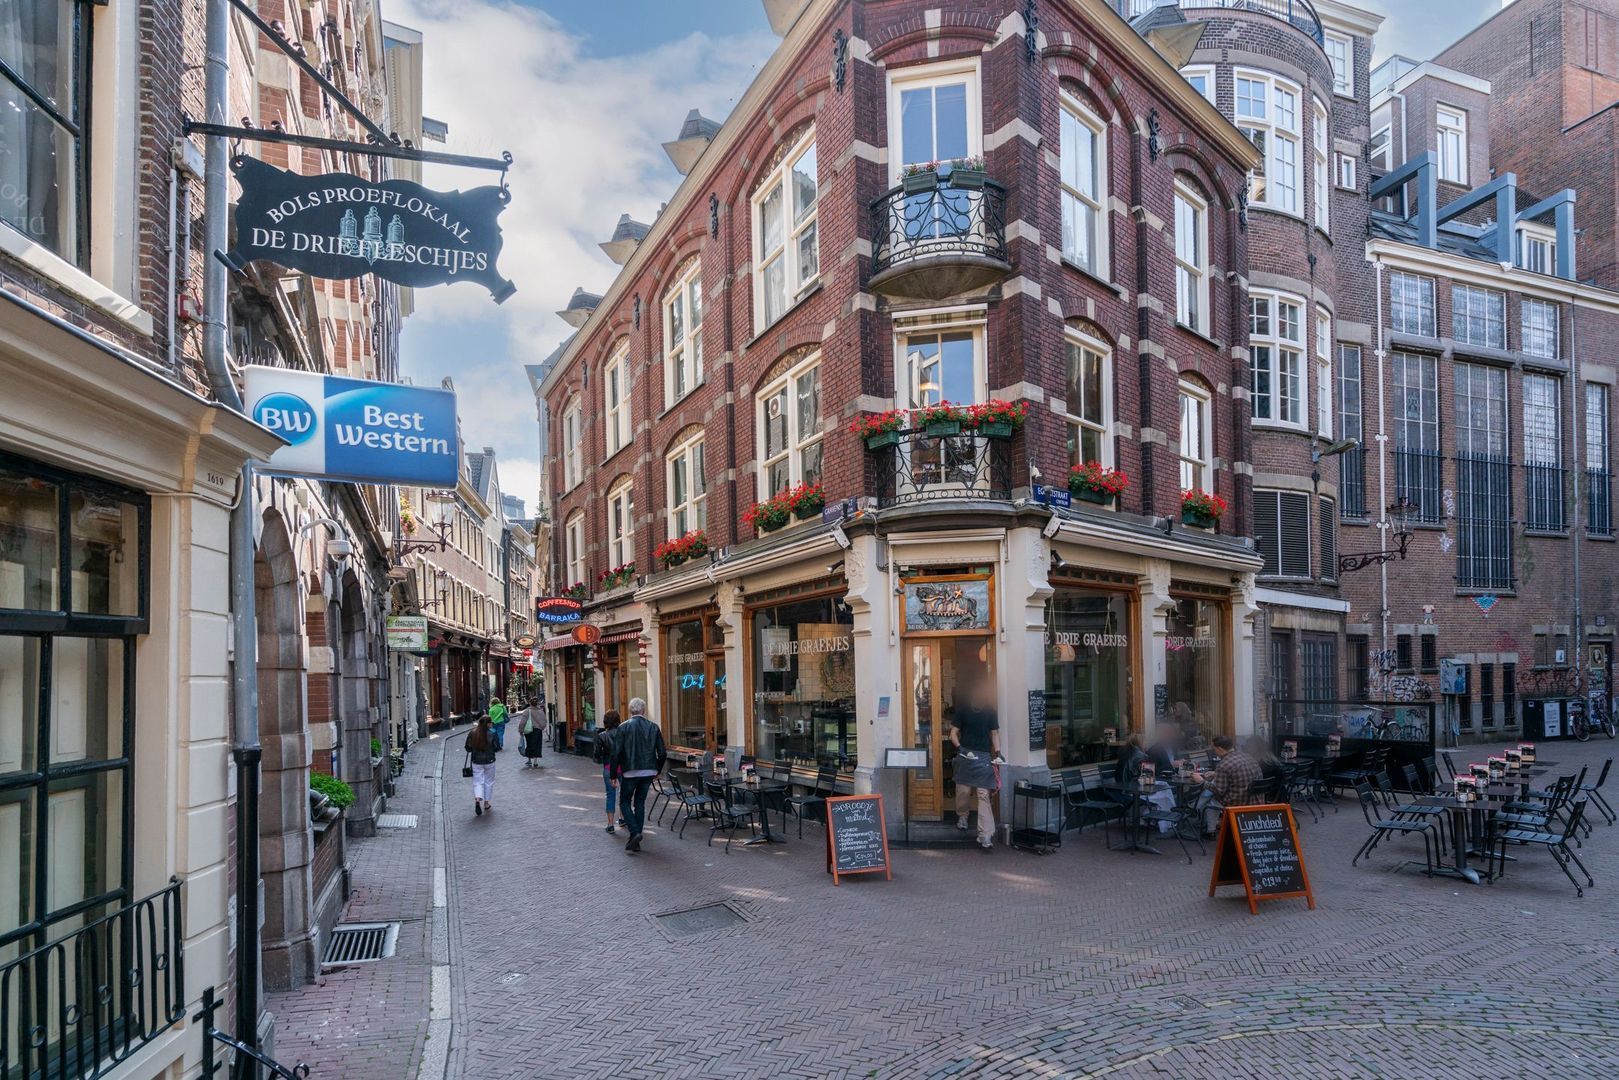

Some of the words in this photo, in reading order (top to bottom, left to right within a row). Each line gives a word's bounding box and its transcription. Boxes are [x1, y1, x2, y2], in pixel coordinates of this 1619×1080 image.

[266, 191, 322, 225] BOLS
[323, 187, 475, 245] PROEFLOKAAL
[251, 227, 287, 249] DE
[292, 232, 352, 256] DRIE
[357, 238, 488, 275] FLESCHJES
[261, 407, 312, 433] BW
[364, 404, 424, 432] Best
[335, 423, 449, 456] Western
[207, 472, 224, 486] 1619
[538, 599, 581, 609] COFFEESHOP
[539, 611, 580, 622] BARRAKA
[778, 640, 799, 656] DRIE
[800, 636, 850, 656] GRAEFJES
[1044, 632, 1050, 645] E
[1055, 632, 1080, 646] DRIE
[1083, 633, 1128, 655] GRAEFJES
